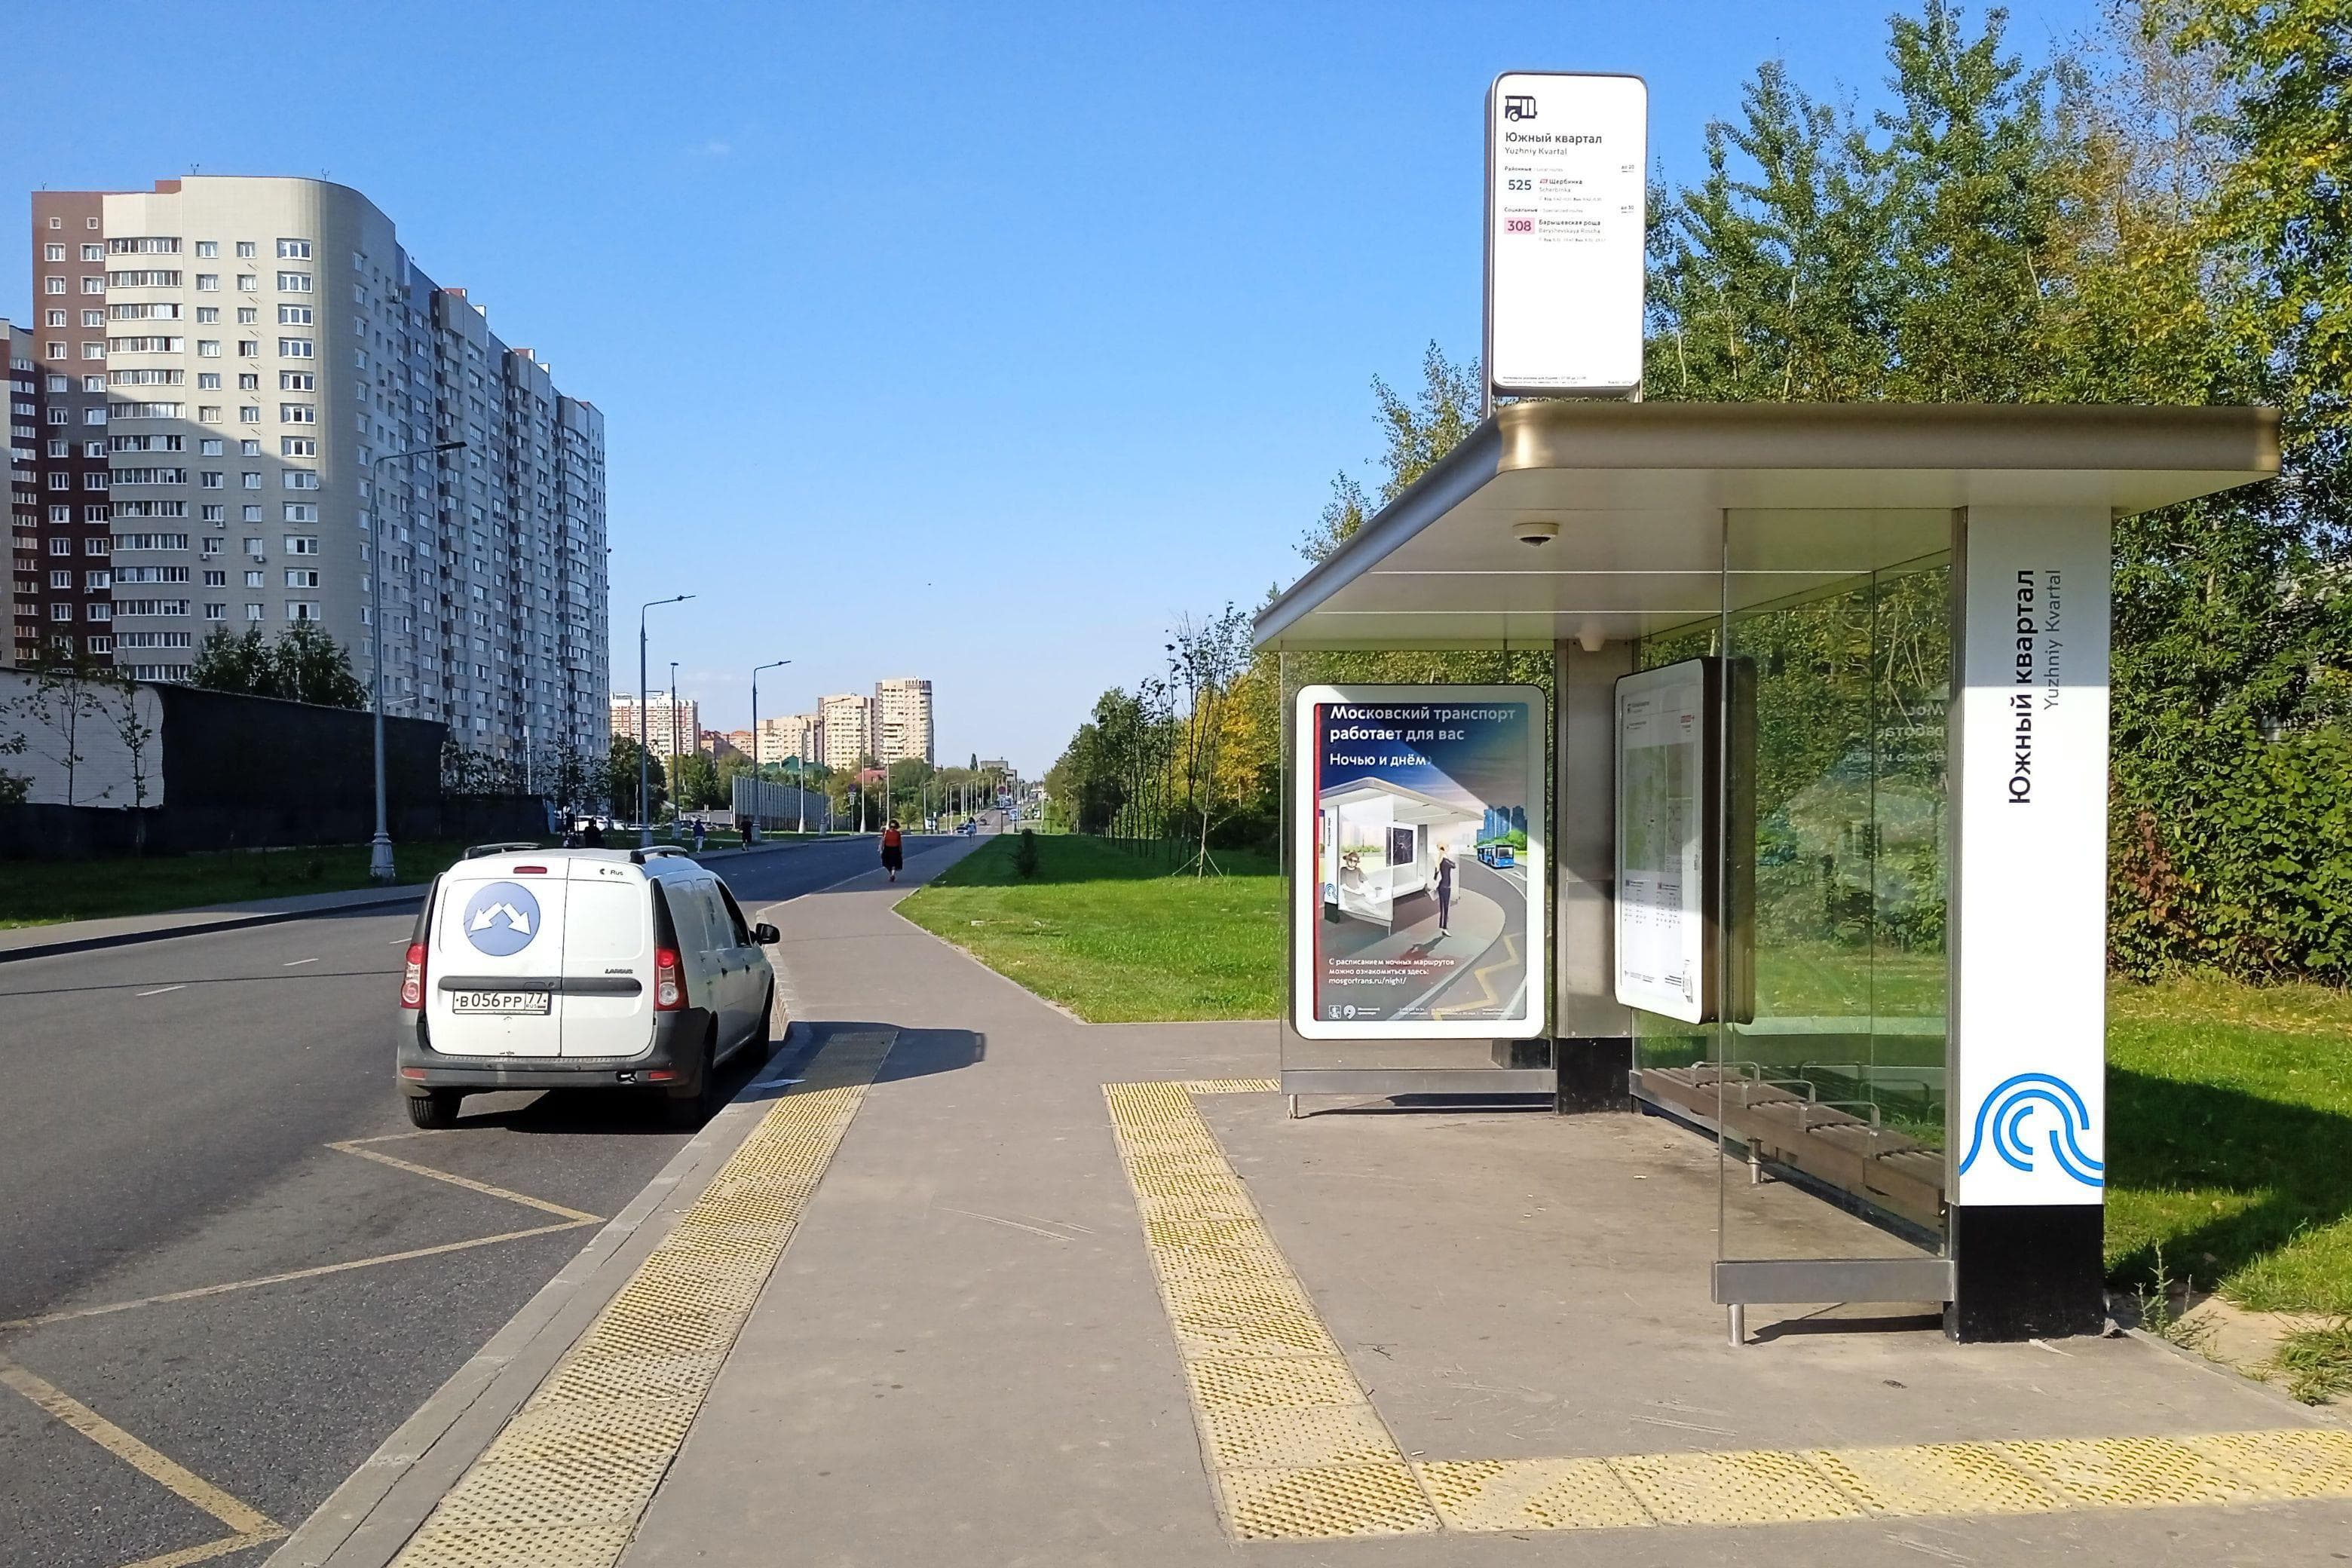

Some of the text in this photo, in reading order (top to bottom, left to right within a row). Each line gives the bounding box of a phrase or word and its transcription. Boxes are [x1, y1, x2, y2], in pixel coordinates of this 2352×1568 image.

[1505, 131, 1602, 145] Южный квартал
[1505, 147, 1537, 156] Yuzhniy
[1508, 179, 1532, 191] 525
[1507, 220, 1532, 231] 308
[2043, 570, 2063, 710] Yuzhniy Kvartal
[2008, 570, 2038, 804] Южный квартал
[1330, 706, 1516, 722] Московский транспорт
[1329, 727, 1465, 743] работает для вас
[1329, 753, 1376, 766] Ночью
[1379, 756, 1387, 766] и
[1413, 959, 1456, 967] маршрутов
[1328, 976, 1407, 986] mosgortrans.ru/night/
[528, 992, 544, 1004] 77
